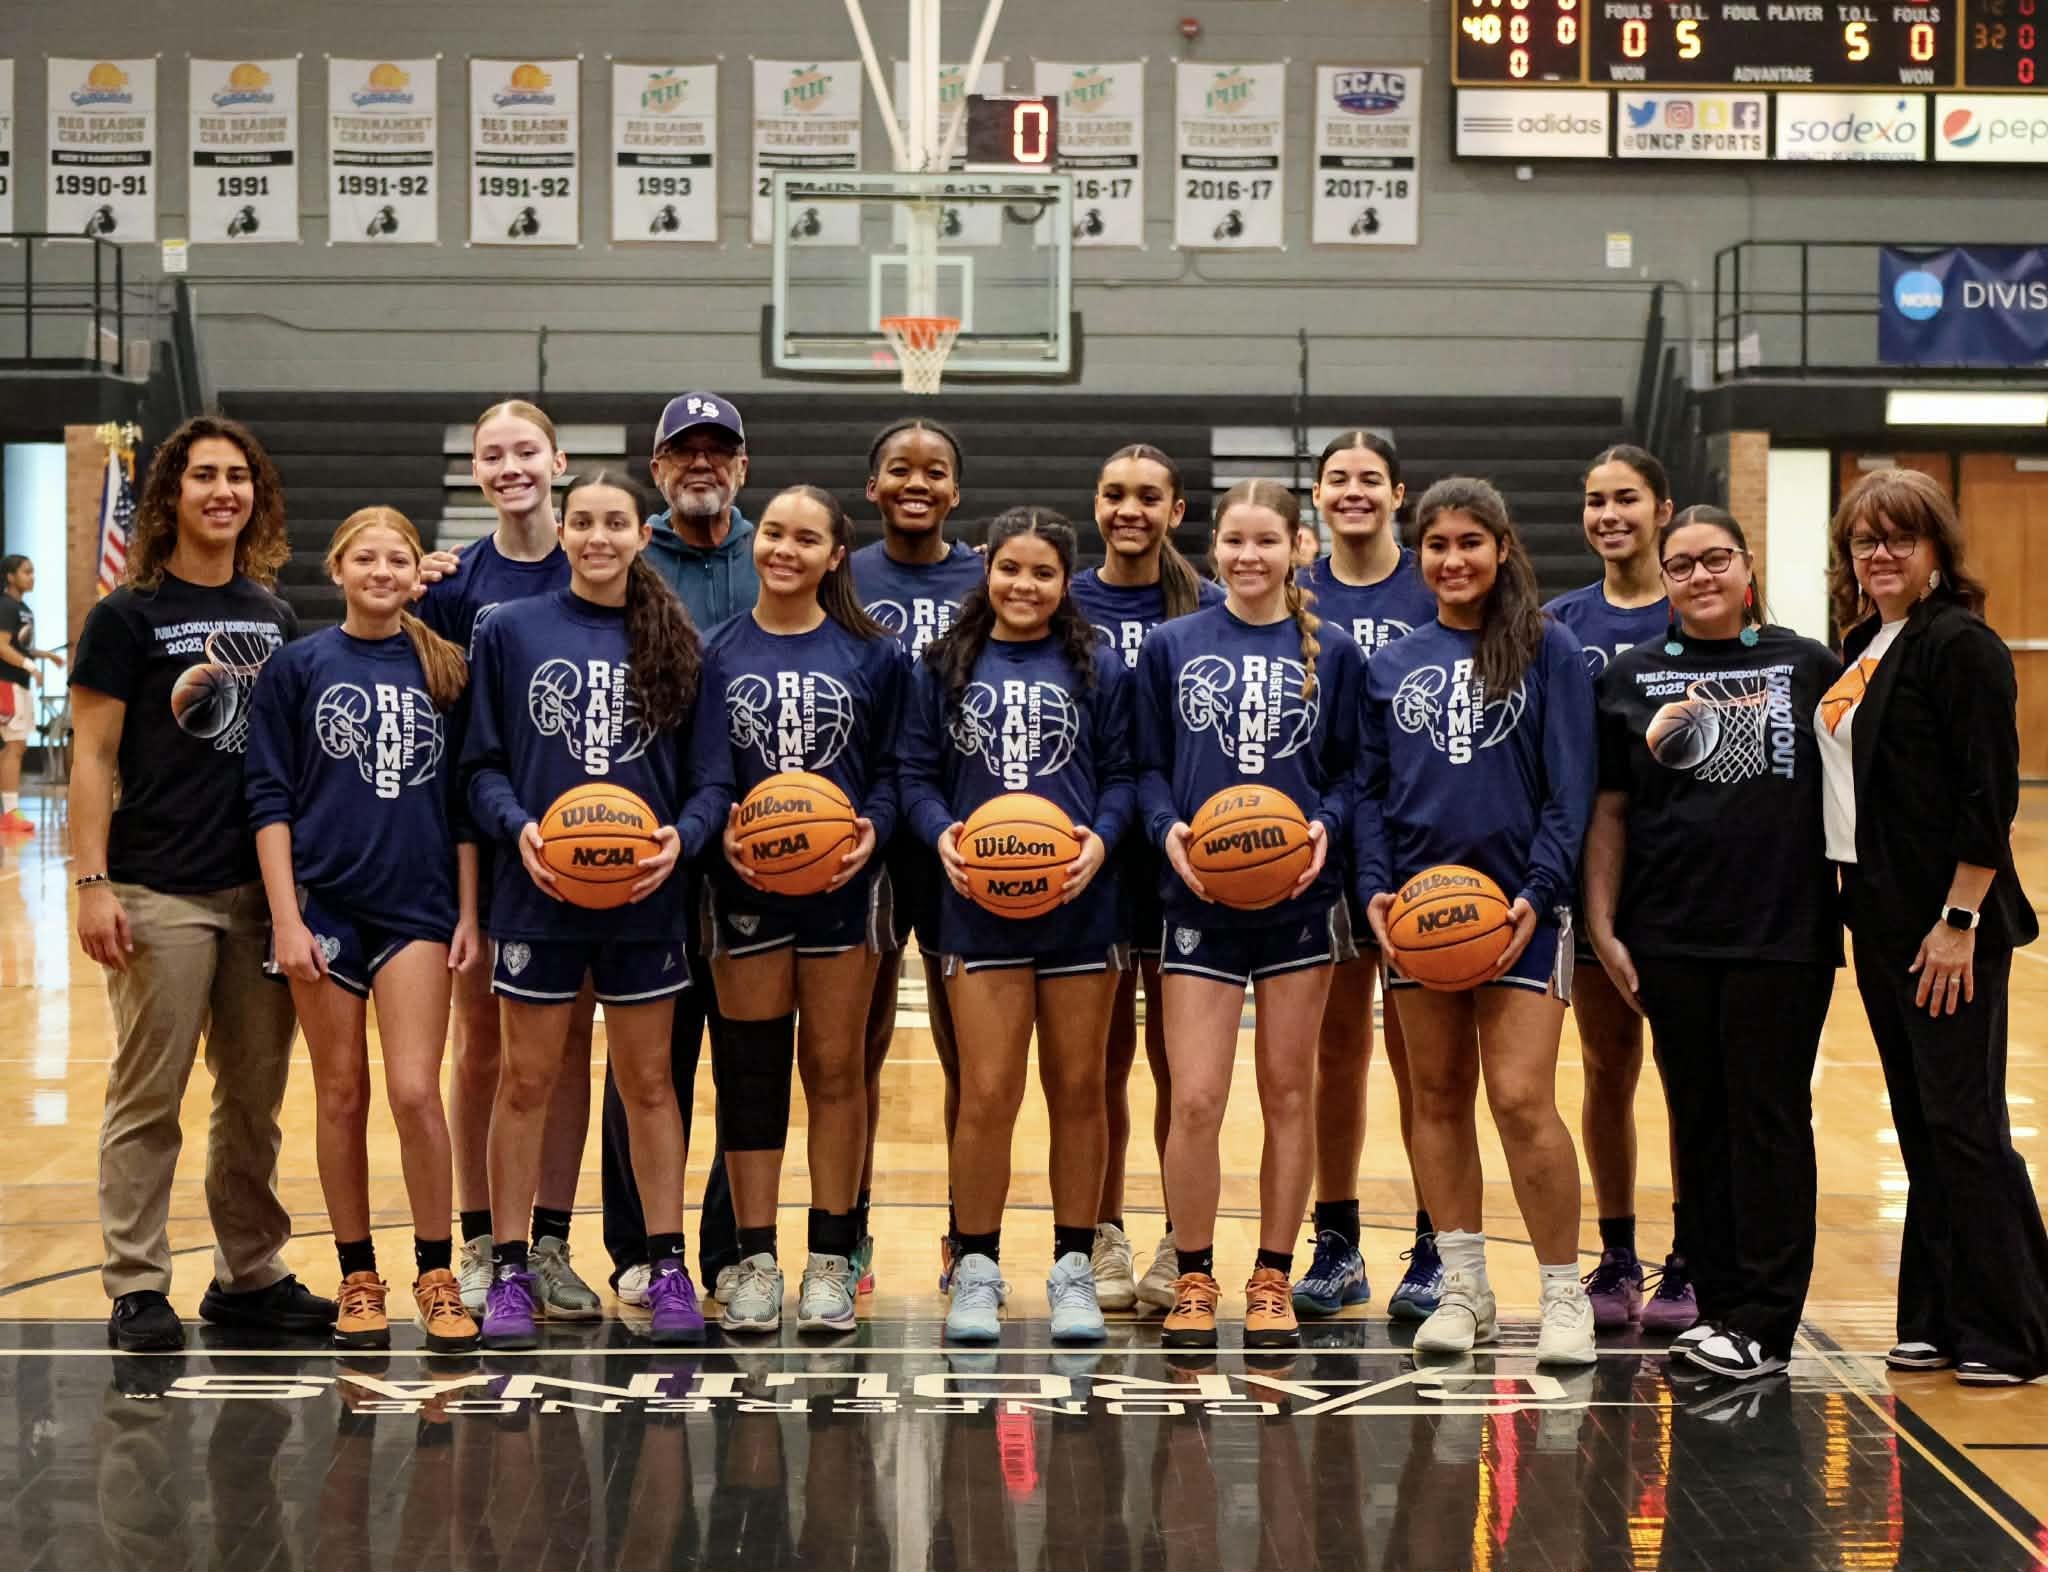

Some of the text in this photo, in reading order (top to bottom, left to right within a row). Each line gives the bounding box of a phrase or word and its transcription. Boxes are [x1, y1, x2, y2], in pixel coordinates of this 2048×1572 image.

[1604, 4, 1653, 20] FOULS
[1670, 5, 1709, 20] T.O.L.
[1722, 5, 1823, 22] FOUL PLAYER
[1838, 7, 1878, 22] T.O.L.
[1893, 7, 1941, 23] FOULS
[1510, 15, 1529, 44] 0
[1557, 15, 1576, 44] 0
[1622, 20, 1647, 57] 0
[1676, 19, 1701, 58] 5
[1844, 22, 1870, 61] 5
[1910, 23, 1934, 61] 0
[2018, 24, 2034, 50] 0
[1510, 49, 1529, 78] 0
[1610, 65, 1646, 81] WON
[1733, 66, 1813, 83] ADVANTAGE
[1900, 69, 1934, 85] WON
[2018, 57, 2034, 84] 0
[1335, 72, 1405, 96] ECAC
[1014, 102, 1048, 163] 0
[1517, 113, 1601, 134] adidas
[1787, 113, 1916, 143] sodexo
[1623, 134, 1762, 151] @UNCP SPORTS
[56, 175, 146, 195] 1990-91
[217, 176, 269, 196] 1991
[338, 175, 428, 196] 1991-92
[479, 176, 570, 197] 1991-92
[637, 177, 692, 196] 1993
[1075, 179, 1132, 199] 16-17
[1187, 179, 1272, 200] 2016-17
[1325, 179, 1408, 198] 2017-18
[1963, 281, 2048, 309] DIVIS
[912, 598, 936, 662] RA
[166, 637, 204, 654] 2025
[1636, 671, 1665, 684] PUBLIC
[1646, 681, 1685, 696] 2025
[611, 668, 624, 746] BASKETBALL
[803, 677, 816, 753] BASKETBALL
[1238, 655, 1267, 774] RAMS
[1267, 662, 1283, 741] BASKETBALL
[1448, 658, 1475, 764] RAMS
[401, 692, 415, 769] BASKETBALL
[585, 660, 610, 775] RAMS
[777, 672, 803, 773] RAMS
[1029, 686, 1040, 760] BASKETBALL
[376, 684, 401, 798] RAMS
[1002, 680, 1028, 790] RAMS
[561, 804, 643, 830] Wilson
[741, 796, 814, 826] Wilson
[751, 832, 810, 860] NCAA
[974, 835, 1056, 858] Wilson
[1204, 826, 1288, 857] Wilson
[572, 847, 635, 866] NCAA
[987, 877, 1048, 897] NCAA
[1401, 874, 1482, 904] Wilson
[1417, 903, 1480, 934] NCAA
[164, 1370, 1567, 1407] CAROLINAS
[352, 1400, 1279, 1416] CONFERENCE
